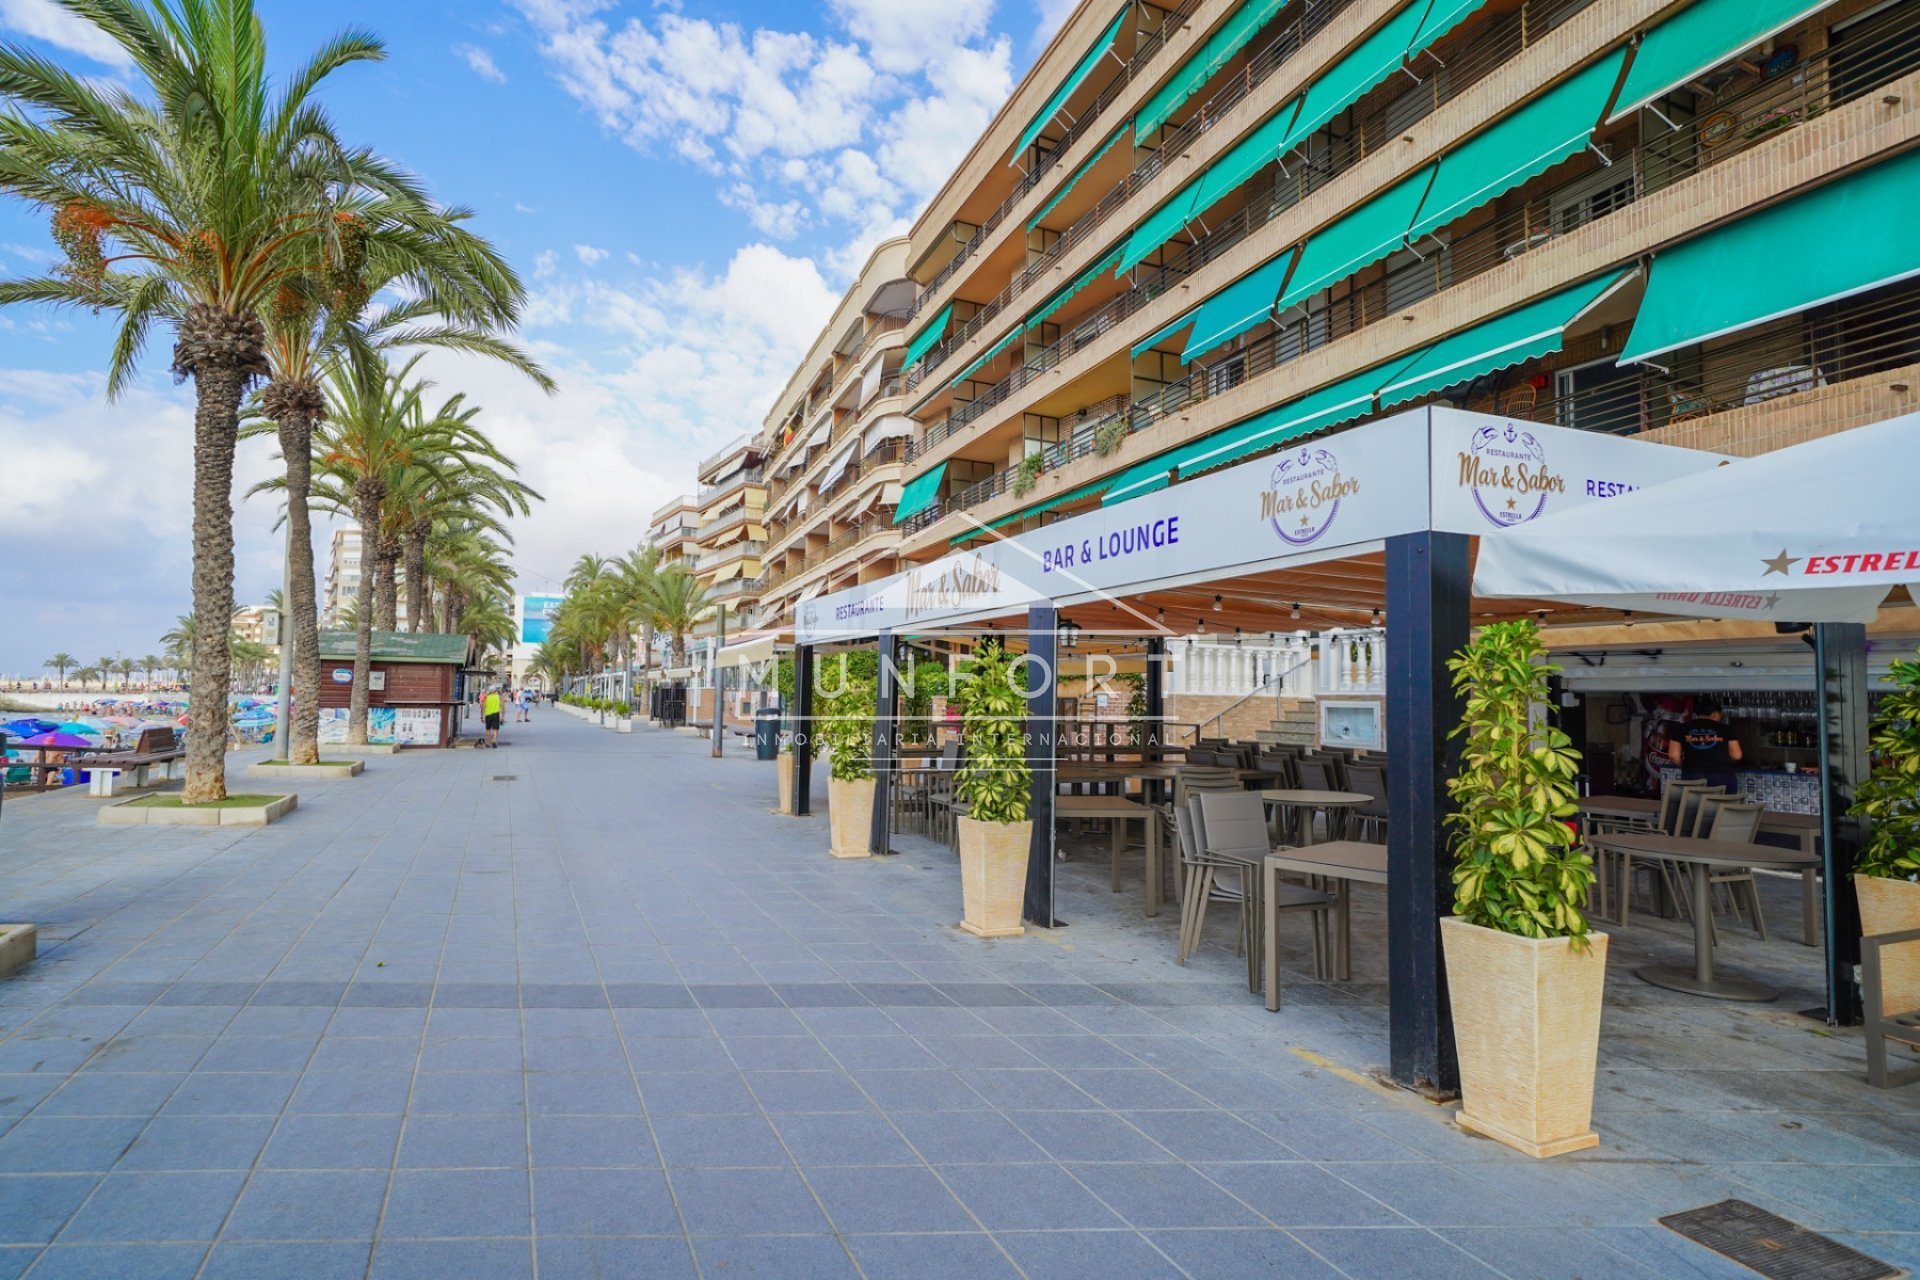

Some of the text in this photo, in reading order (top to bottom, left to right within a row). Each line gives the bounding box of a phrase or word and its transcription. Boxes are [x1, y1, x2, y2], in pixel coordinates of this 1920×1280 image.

[1283, 468, 1325, 485] RESTAURANTE
[1458, 452, 1566, 496] Mar & Sabor
[1486, 448, 1532, 462] RESTAURANTE
[1260, 472, 1360, 522] Mar & Sabor
[1586, 479, 1640, 498] REST
[1043, 516, 1179, 573] BAR & LOUNGE
[835, 552, 1001, 621] RESTAURANTE Mar & Sabor
